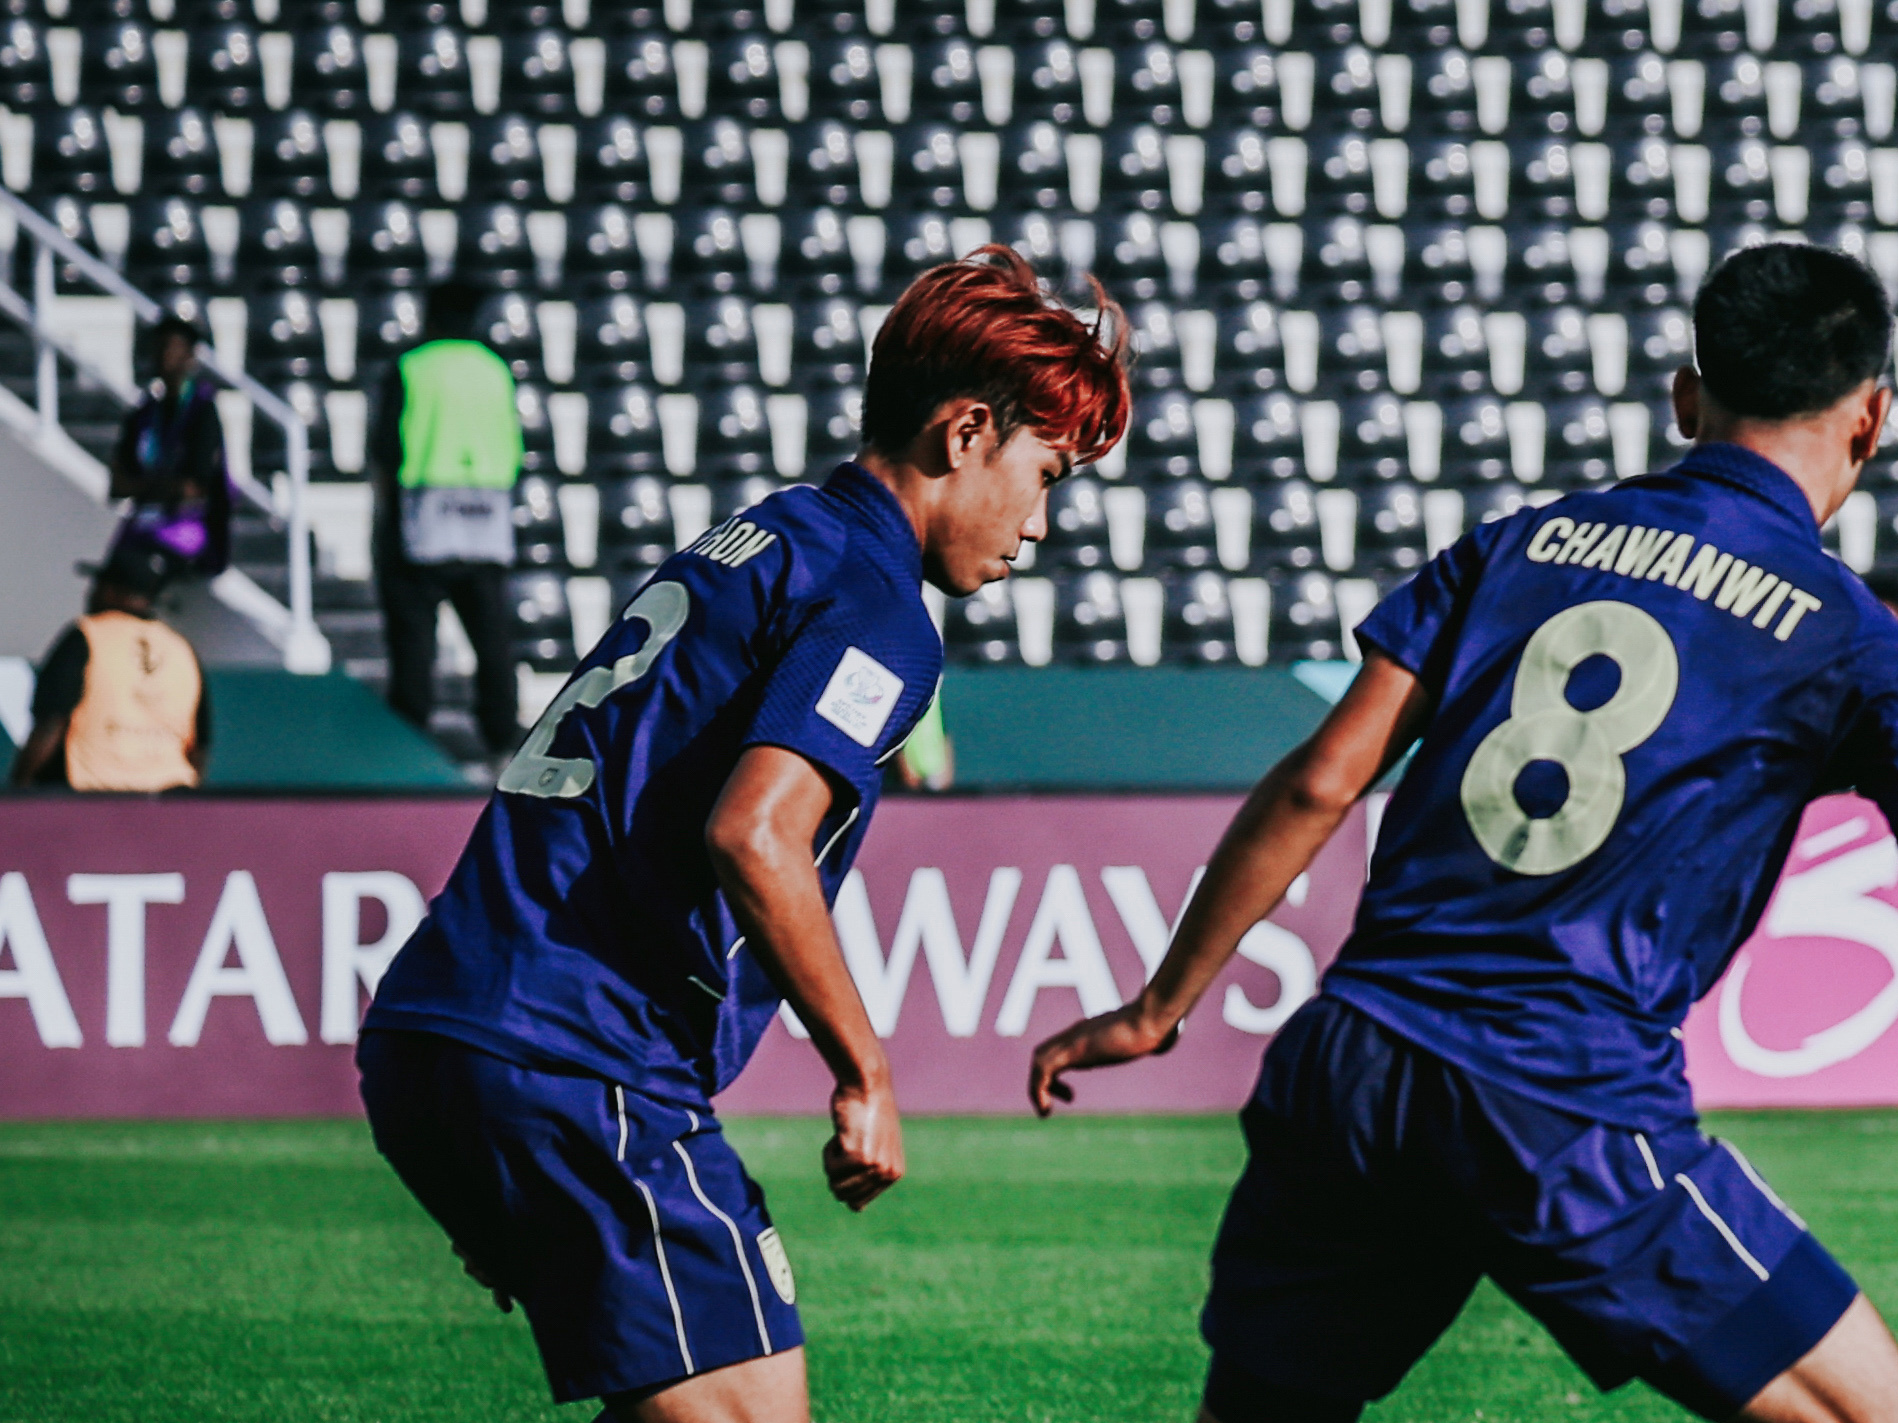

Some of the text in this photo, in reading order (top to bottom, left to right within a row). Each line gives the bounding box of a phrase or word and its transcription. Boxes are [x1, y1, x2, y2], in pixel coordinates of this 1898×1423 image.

[1526, 516, 1822, 641] CHAWANWIT
[496, 579, 690, 799] 2
[1460, 600, 1679, 876] 8
